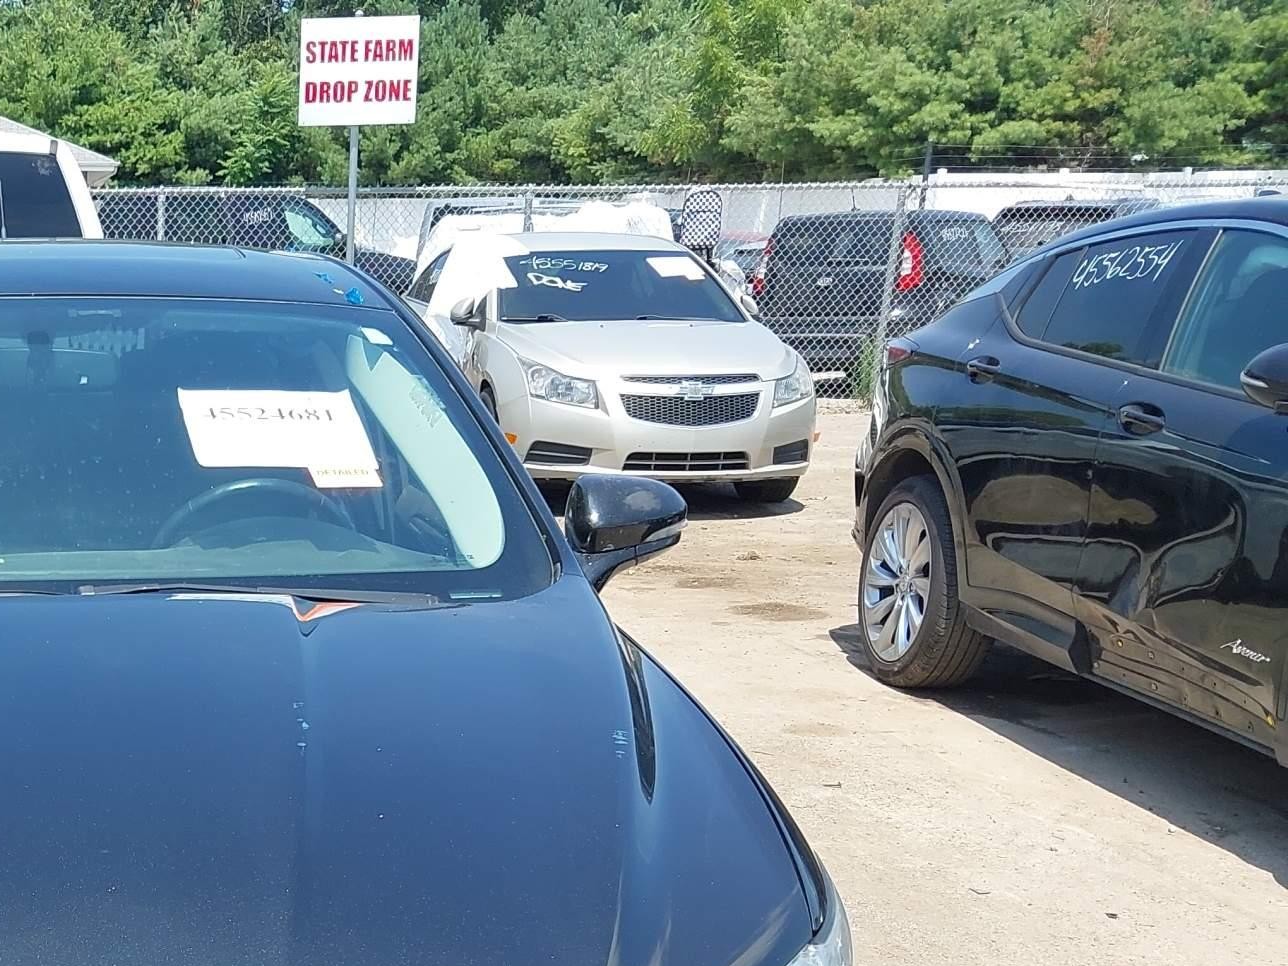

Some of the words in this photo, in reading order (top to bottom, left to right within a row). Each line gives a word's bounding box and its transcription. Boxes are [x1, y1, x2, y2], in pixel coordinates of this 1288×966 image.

[305, 40, 359, 64] STATE
[364, 39, 414, 62] FARM
[304, 80, 359, 104] DROP
[363, 79, 412, 102] ZONE
[1072, 239, 1184, 290] 45562554
[527, 272, 588, 292] DONE
